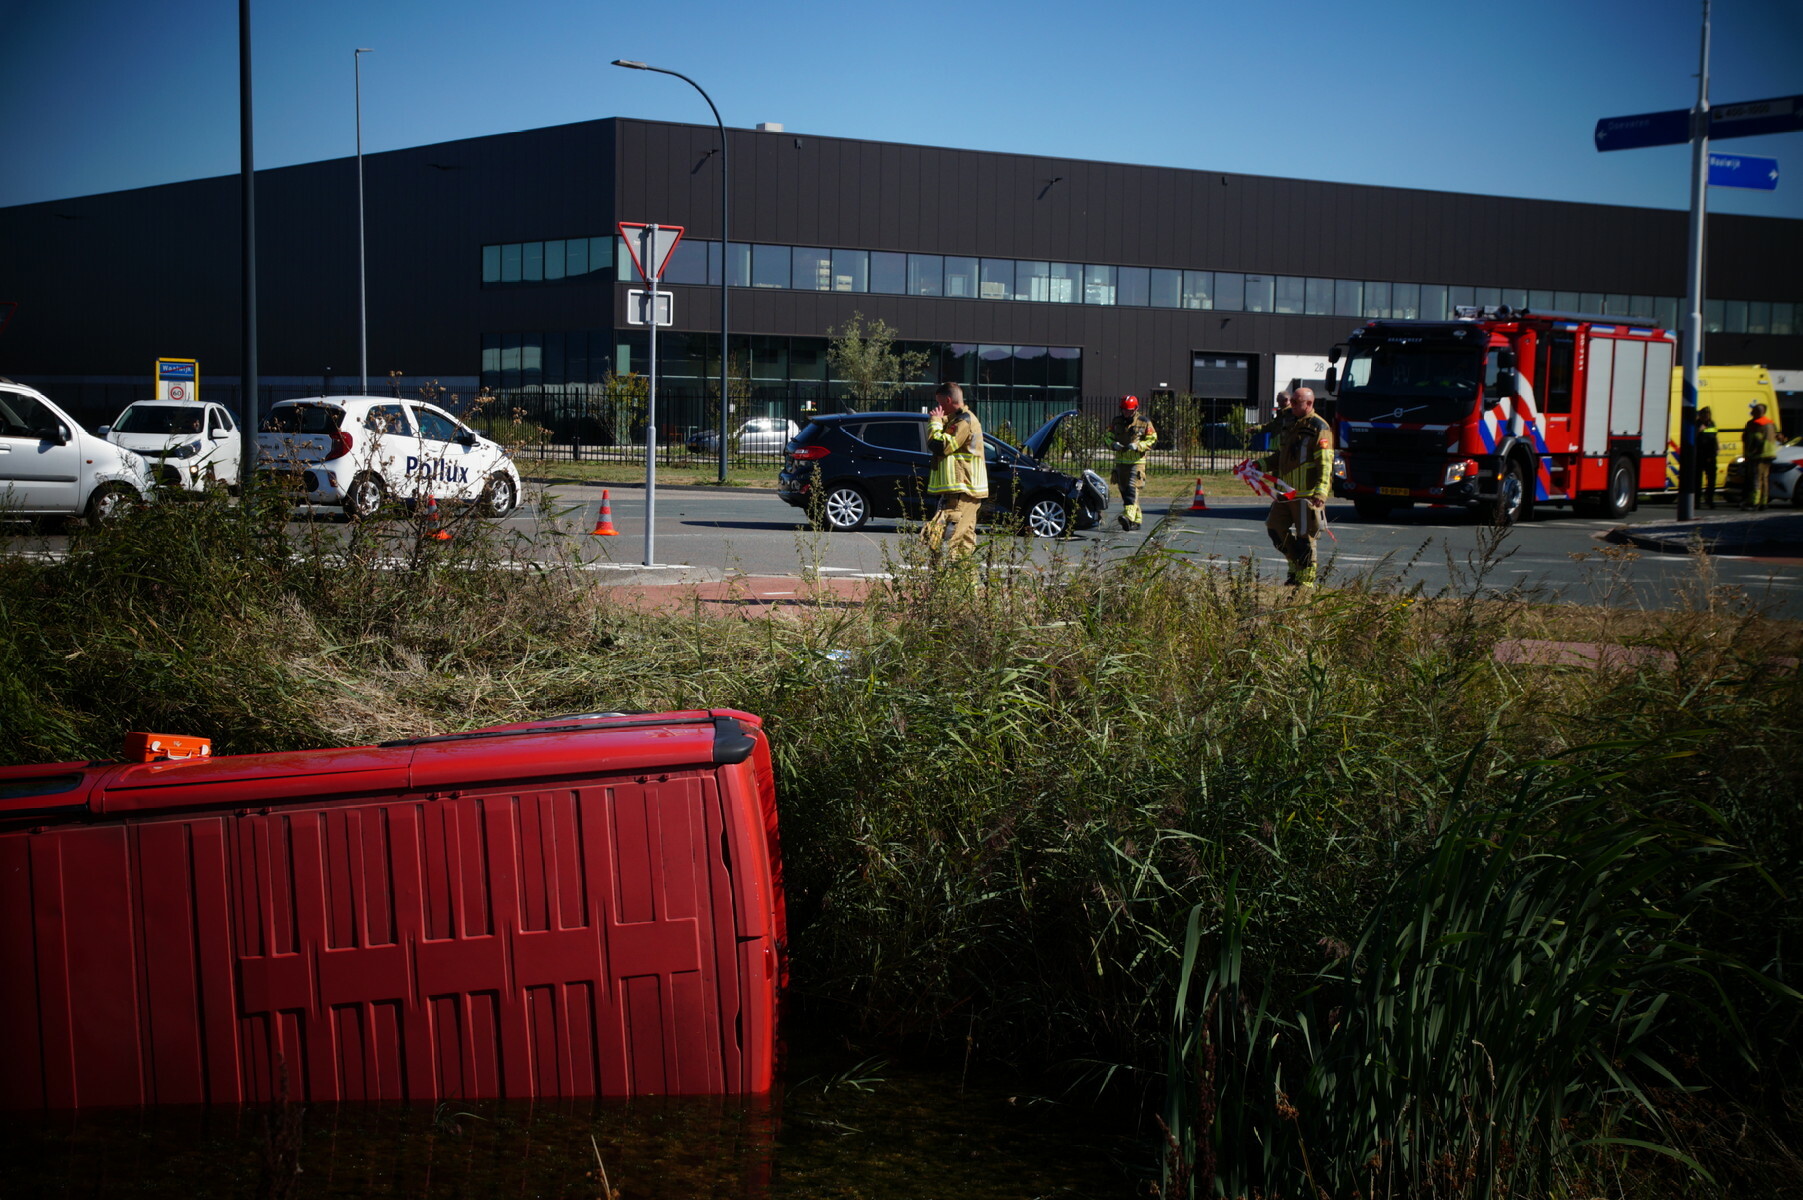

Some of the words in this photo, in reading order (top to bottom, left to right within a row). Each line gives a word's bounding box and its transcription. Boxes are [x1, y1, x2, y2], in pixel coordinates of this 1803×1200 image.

[162, 365, 191, 373] Waalwijk
[1314, 362, 1325, 372] 28
[406, 456, 468, 484] Pollux
